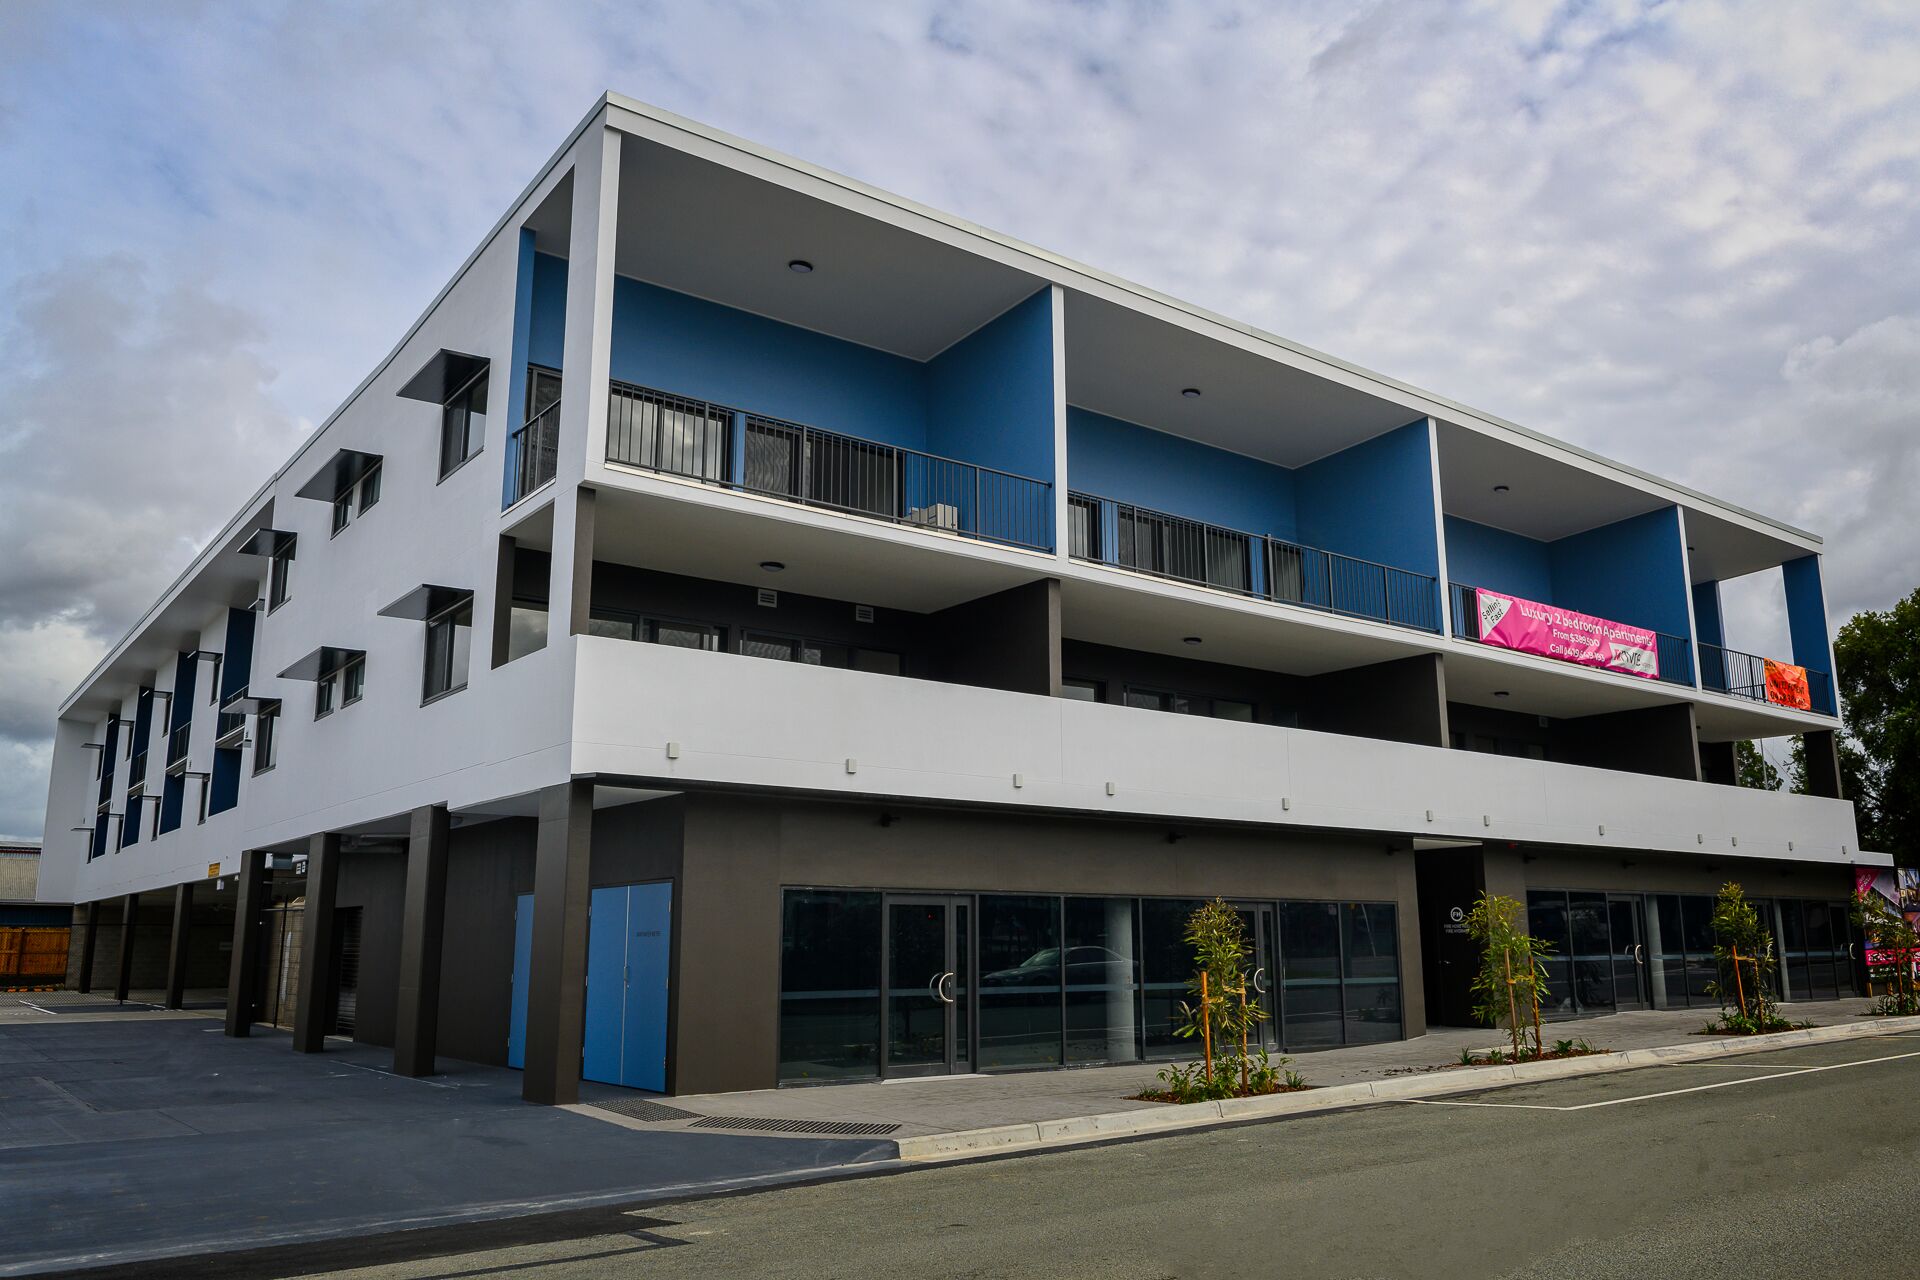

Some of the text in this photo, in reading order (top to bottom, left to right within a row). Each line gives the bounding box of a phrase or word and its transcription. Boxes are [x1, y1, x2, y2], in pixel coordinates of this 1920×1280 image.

[1490, 608, 1503, 624] Fast
[1520, 604, 1653, 647] Luxury 2 bedroom Apartments
[1552, 628, 1570, 642] From
[1549, 643, 1564, 656] Call
